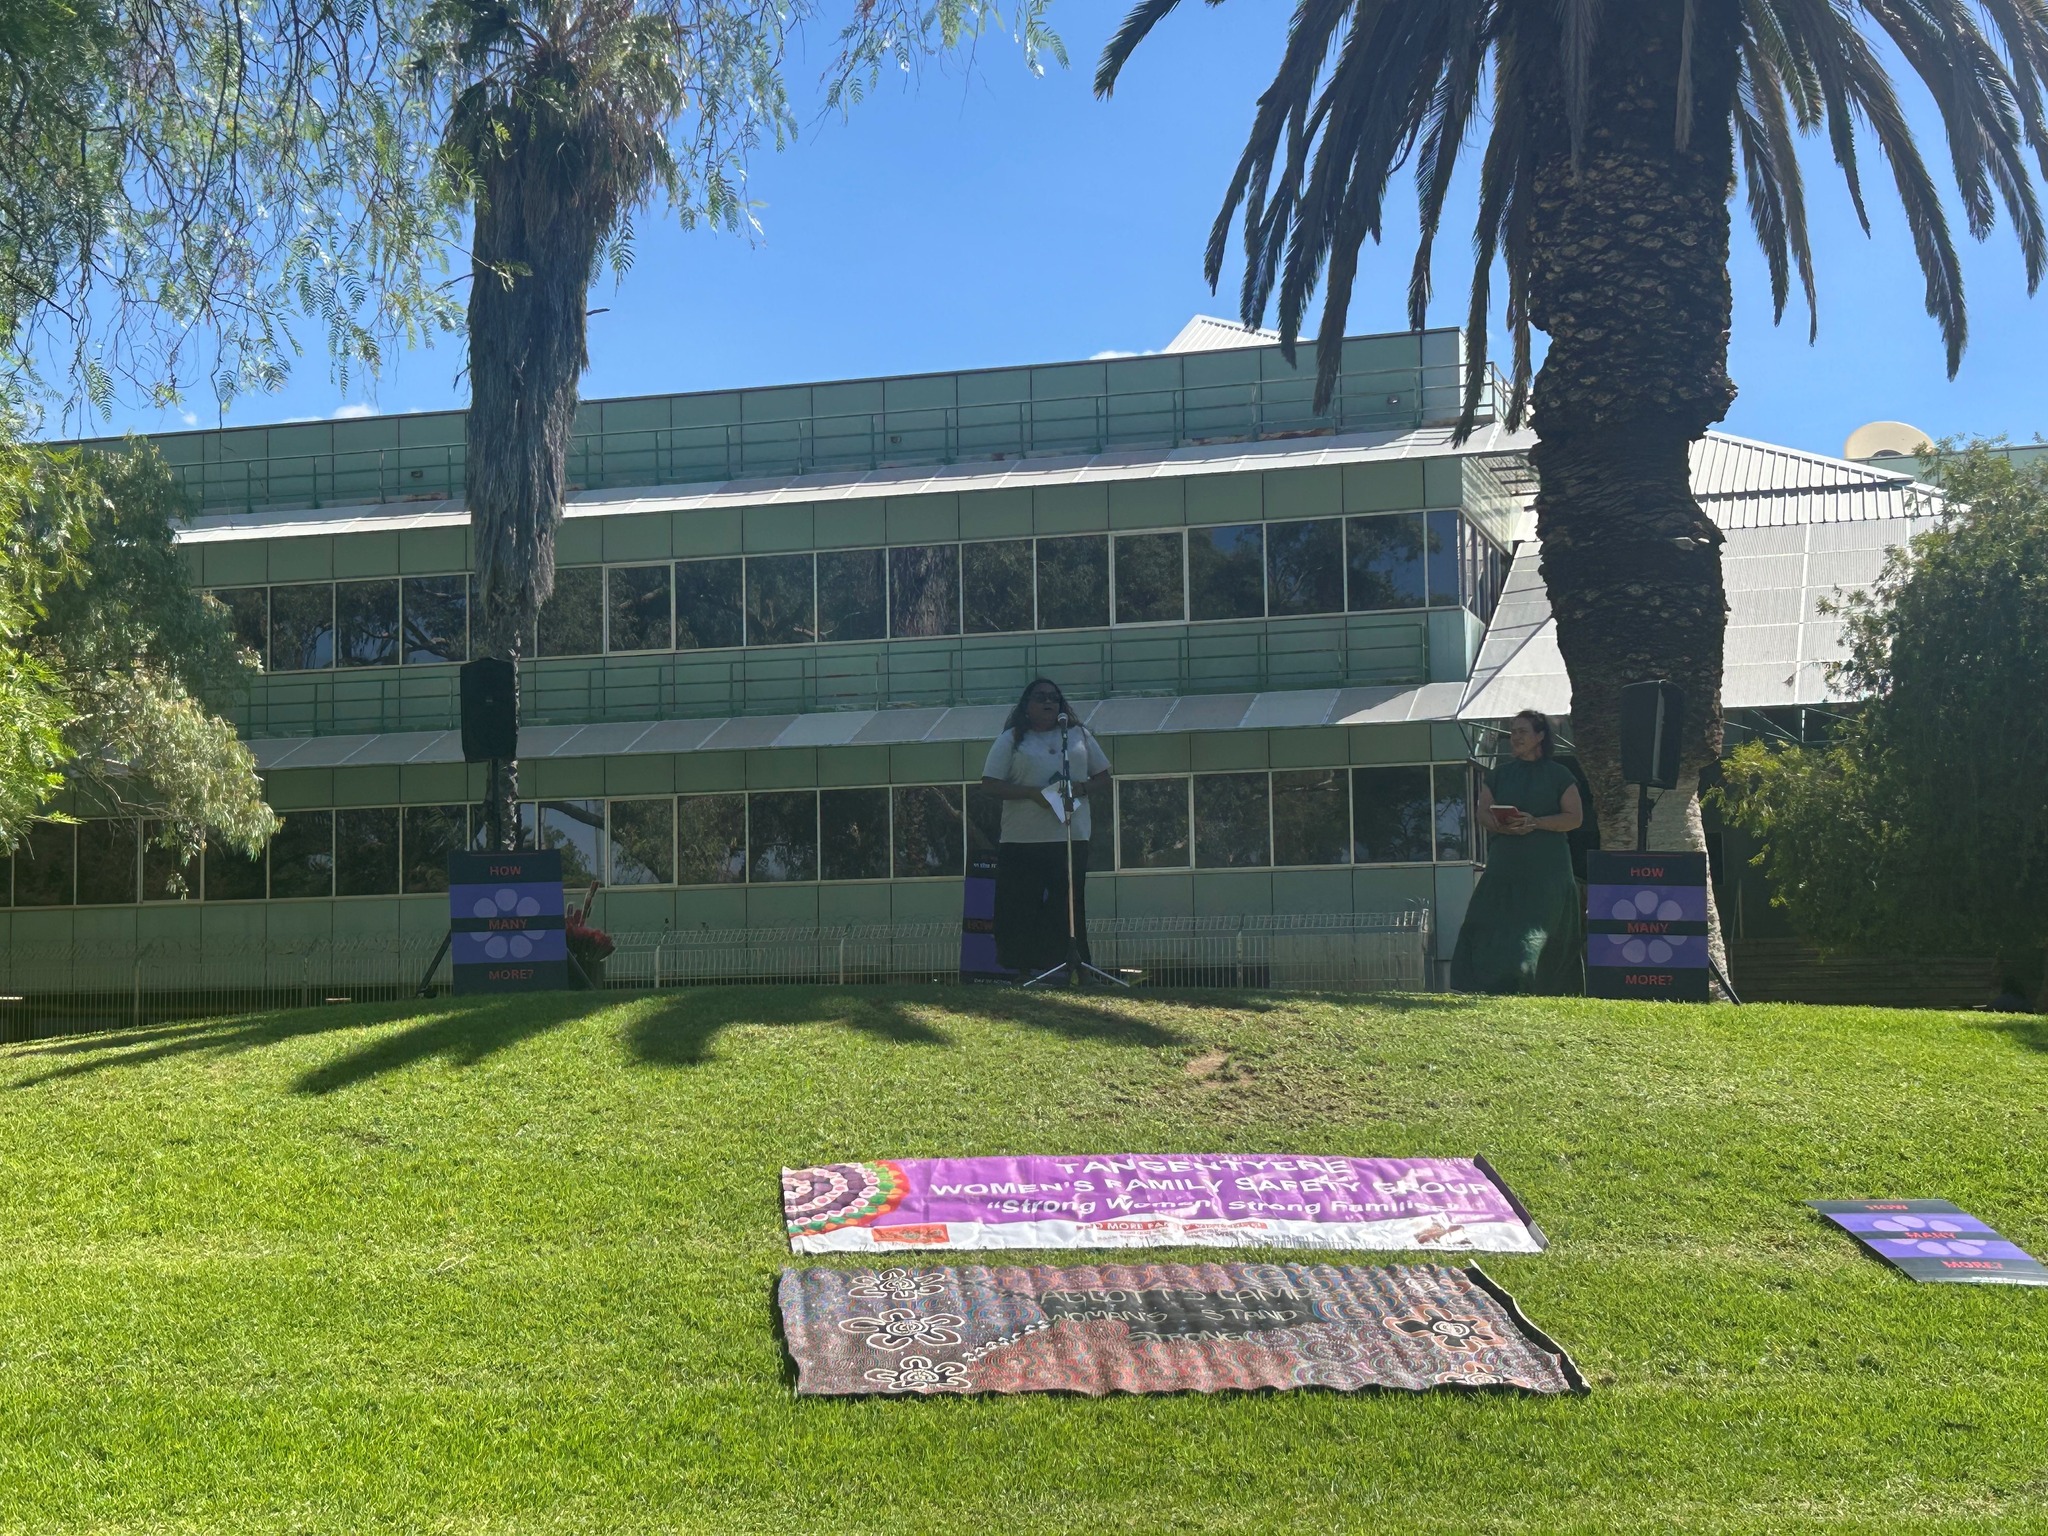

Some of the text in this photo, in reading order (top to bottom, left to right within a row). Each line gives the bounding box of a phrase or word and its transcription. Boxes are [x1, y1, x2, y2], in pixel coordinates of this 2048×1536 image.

[489, 866, 521, 876] HOW
[1630, 867, 1664, 878] HOW
[488, 919, 528, 930] MANY
[1627, 922, 1669, 933] MANY
[488, 969, 534, 980] MORE?
[1625, 974, 1673, 986] MORE?
[930, 1180, 1095, 1196] WOMEN'S
